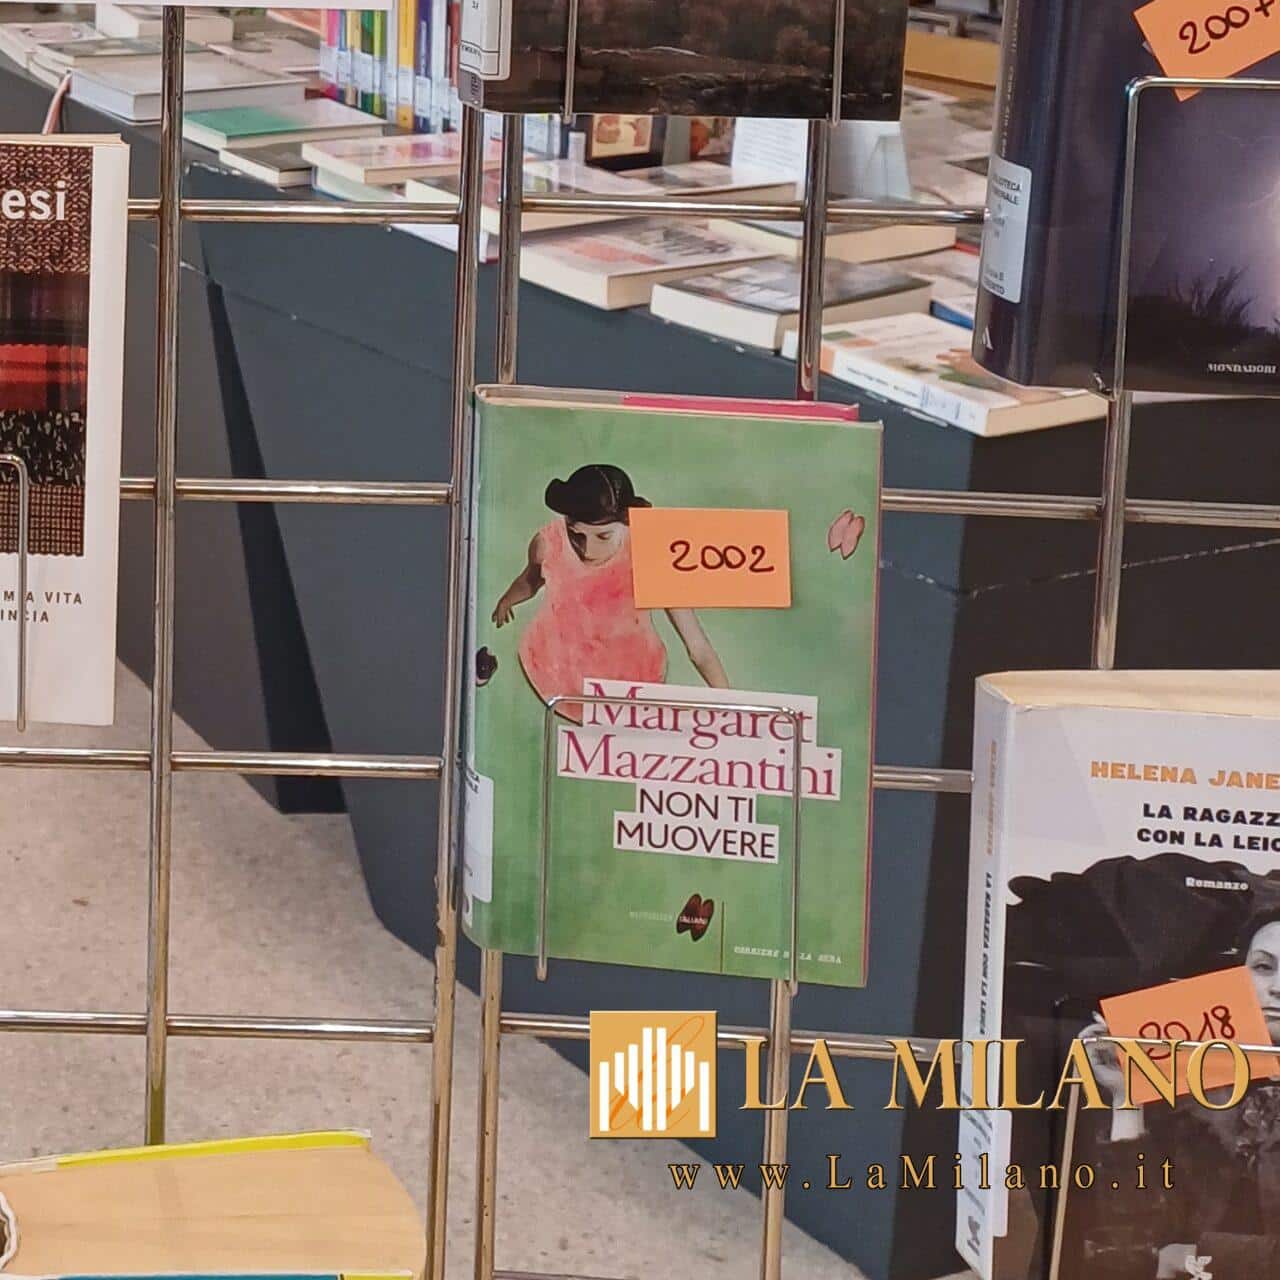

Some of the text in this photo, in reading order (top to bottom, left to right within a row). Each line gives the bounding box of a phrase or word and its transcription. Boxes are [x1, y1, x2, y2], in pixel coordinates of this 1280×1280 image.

[1207, 363, 1276, 374] MONDADORI
[670, 540, 775, 573] 2002
[3, 589, 35, 602] MA
[45, 591, 83, 605] VITA
[587, 682, 812, 750] Margaret
[560, 730, 837, 797] Mazzantini
[1091, 760, 1197, 784] HELENA
[640, 788, 754, 824] NON TI
[1143, 803, 1173, 819] LA
[616, 820, 776, 860] MUOVERE
[1136, 828, 1185, 845] CON
[1194, 832, 1224, 848] LA
[1185, 876, 1249, 890] Romanzo
[733, 945, 780, 959] CORRIERE
